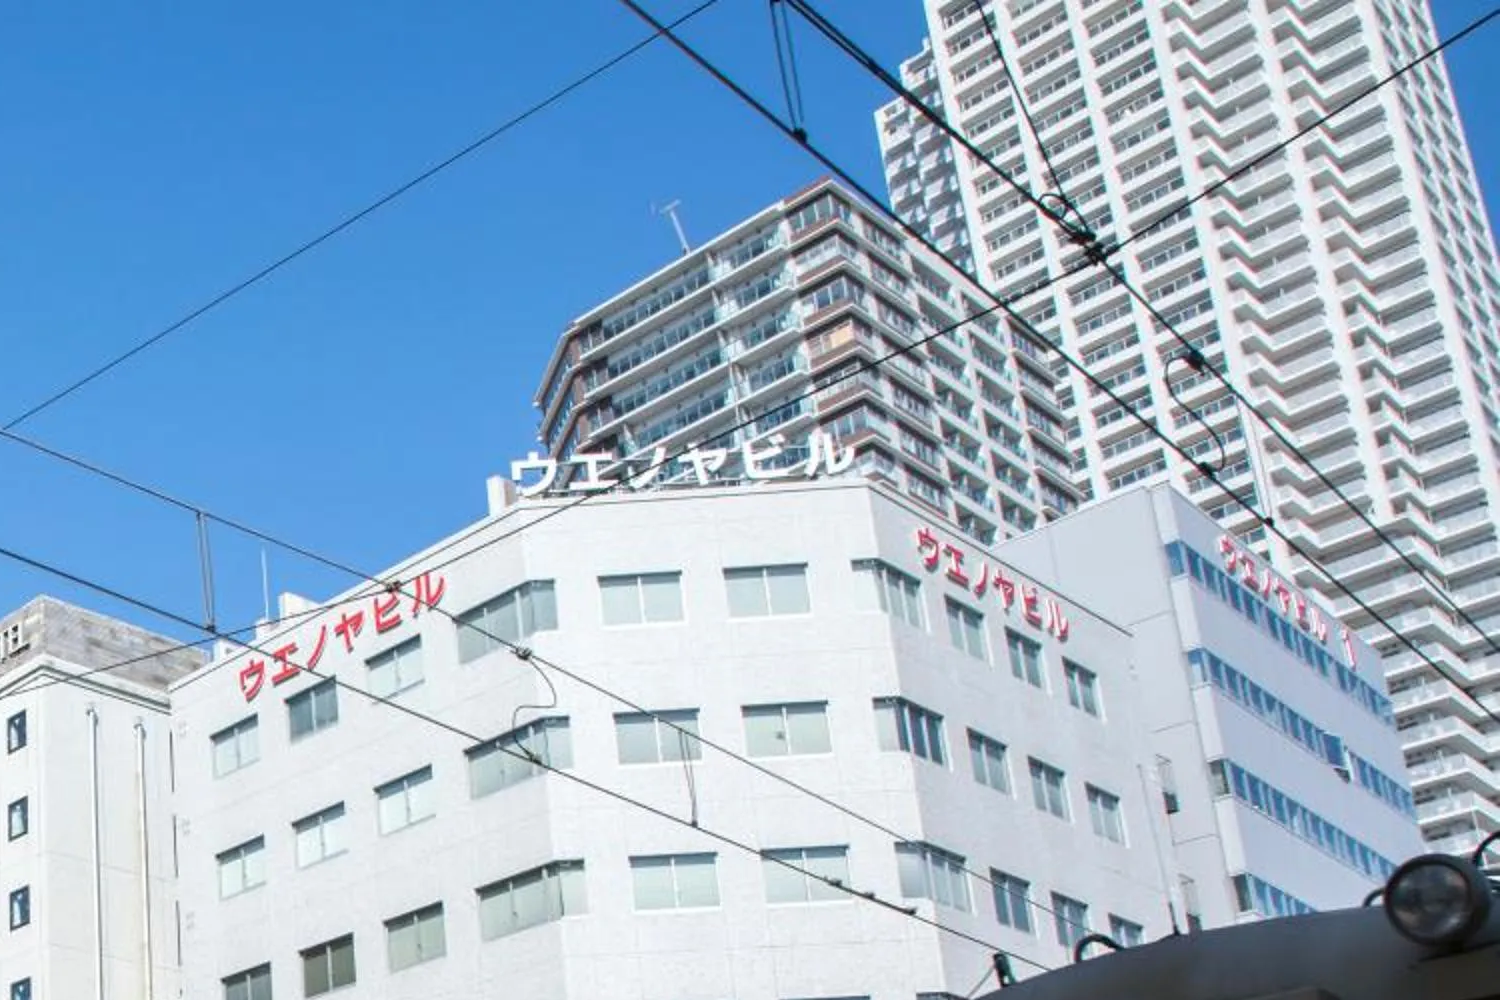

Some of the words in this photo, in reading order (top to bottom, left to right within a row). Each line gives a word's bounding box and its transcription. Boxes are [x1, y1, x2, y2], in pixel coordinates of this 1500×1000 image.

[511, 430, 854, 495] ウエノヤビル
[238, 570, 446, 702] ウエノヤビル
[914, 526, 1070, 641] ウエノヤビル
